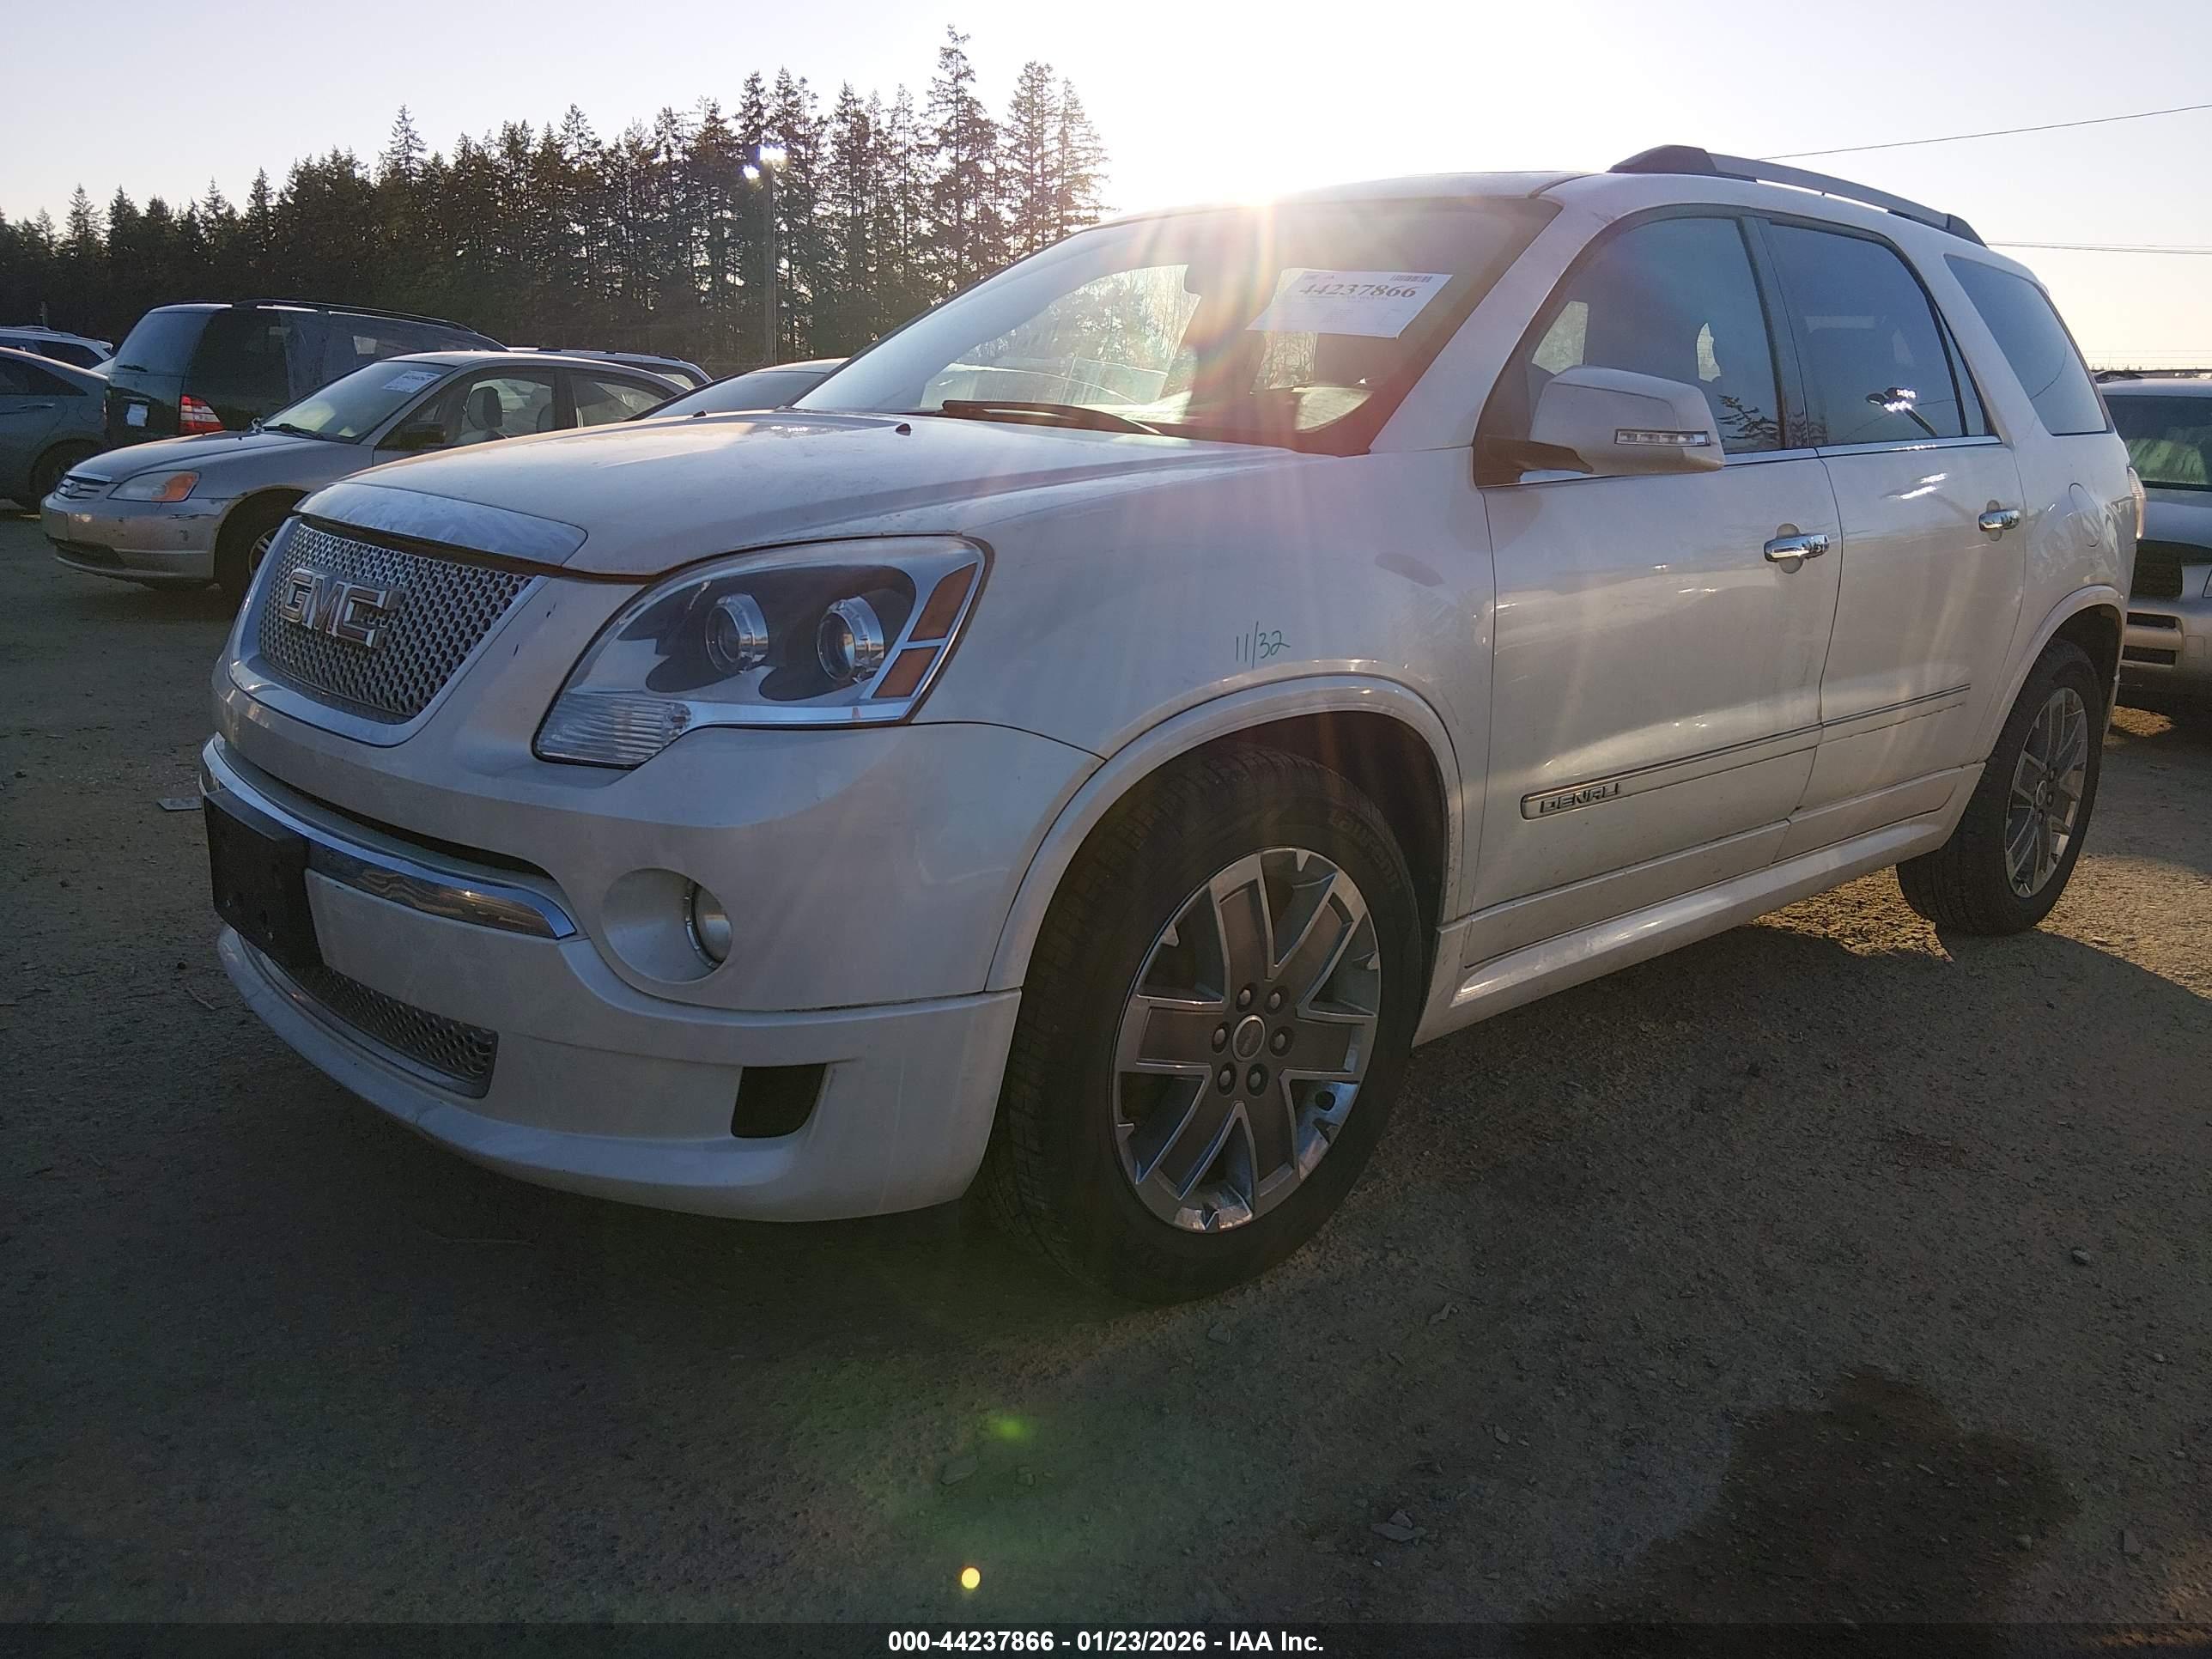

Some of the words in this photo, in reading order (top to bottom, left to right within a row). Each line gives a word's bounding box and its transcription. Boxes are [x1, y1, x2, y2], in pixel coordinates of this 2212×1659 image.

[1299, 283, 1421, 298] 44237866
[281, 567, 388, 647] GMC
[1236, 621, 1291, 668] 11/32
[1539, 782, 1621, 813] DENALI
